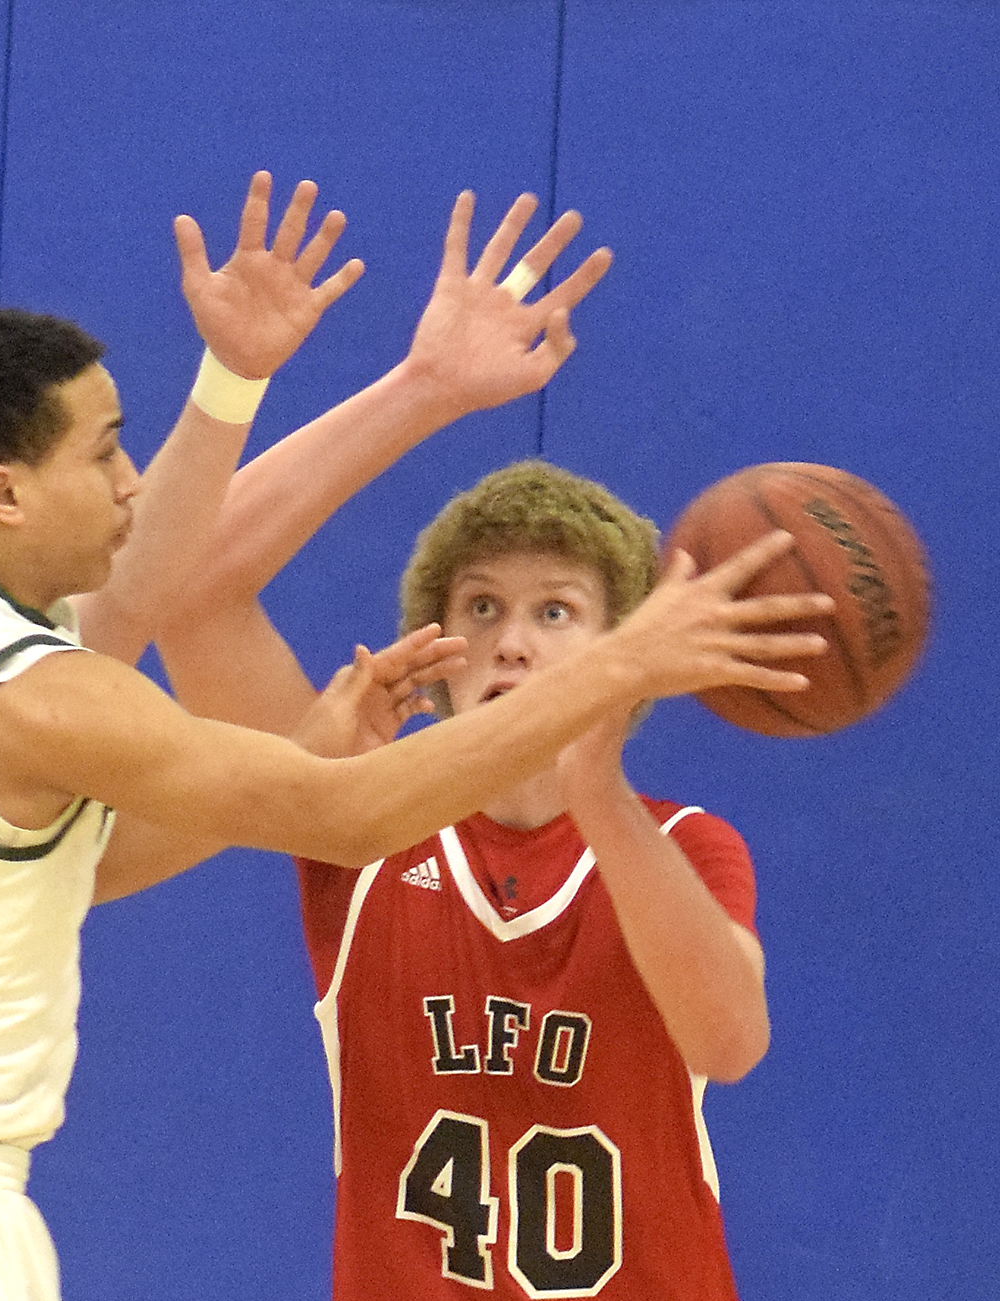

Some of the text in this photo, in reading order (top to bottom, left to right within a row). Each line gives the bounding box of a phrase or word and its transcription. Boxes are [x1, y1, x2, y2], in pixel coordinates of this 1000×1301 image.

[400, 871, 442, 891] adidas
[423, 995, 592, 1087] LFO
[395, 1109, 622, 1299] 40
